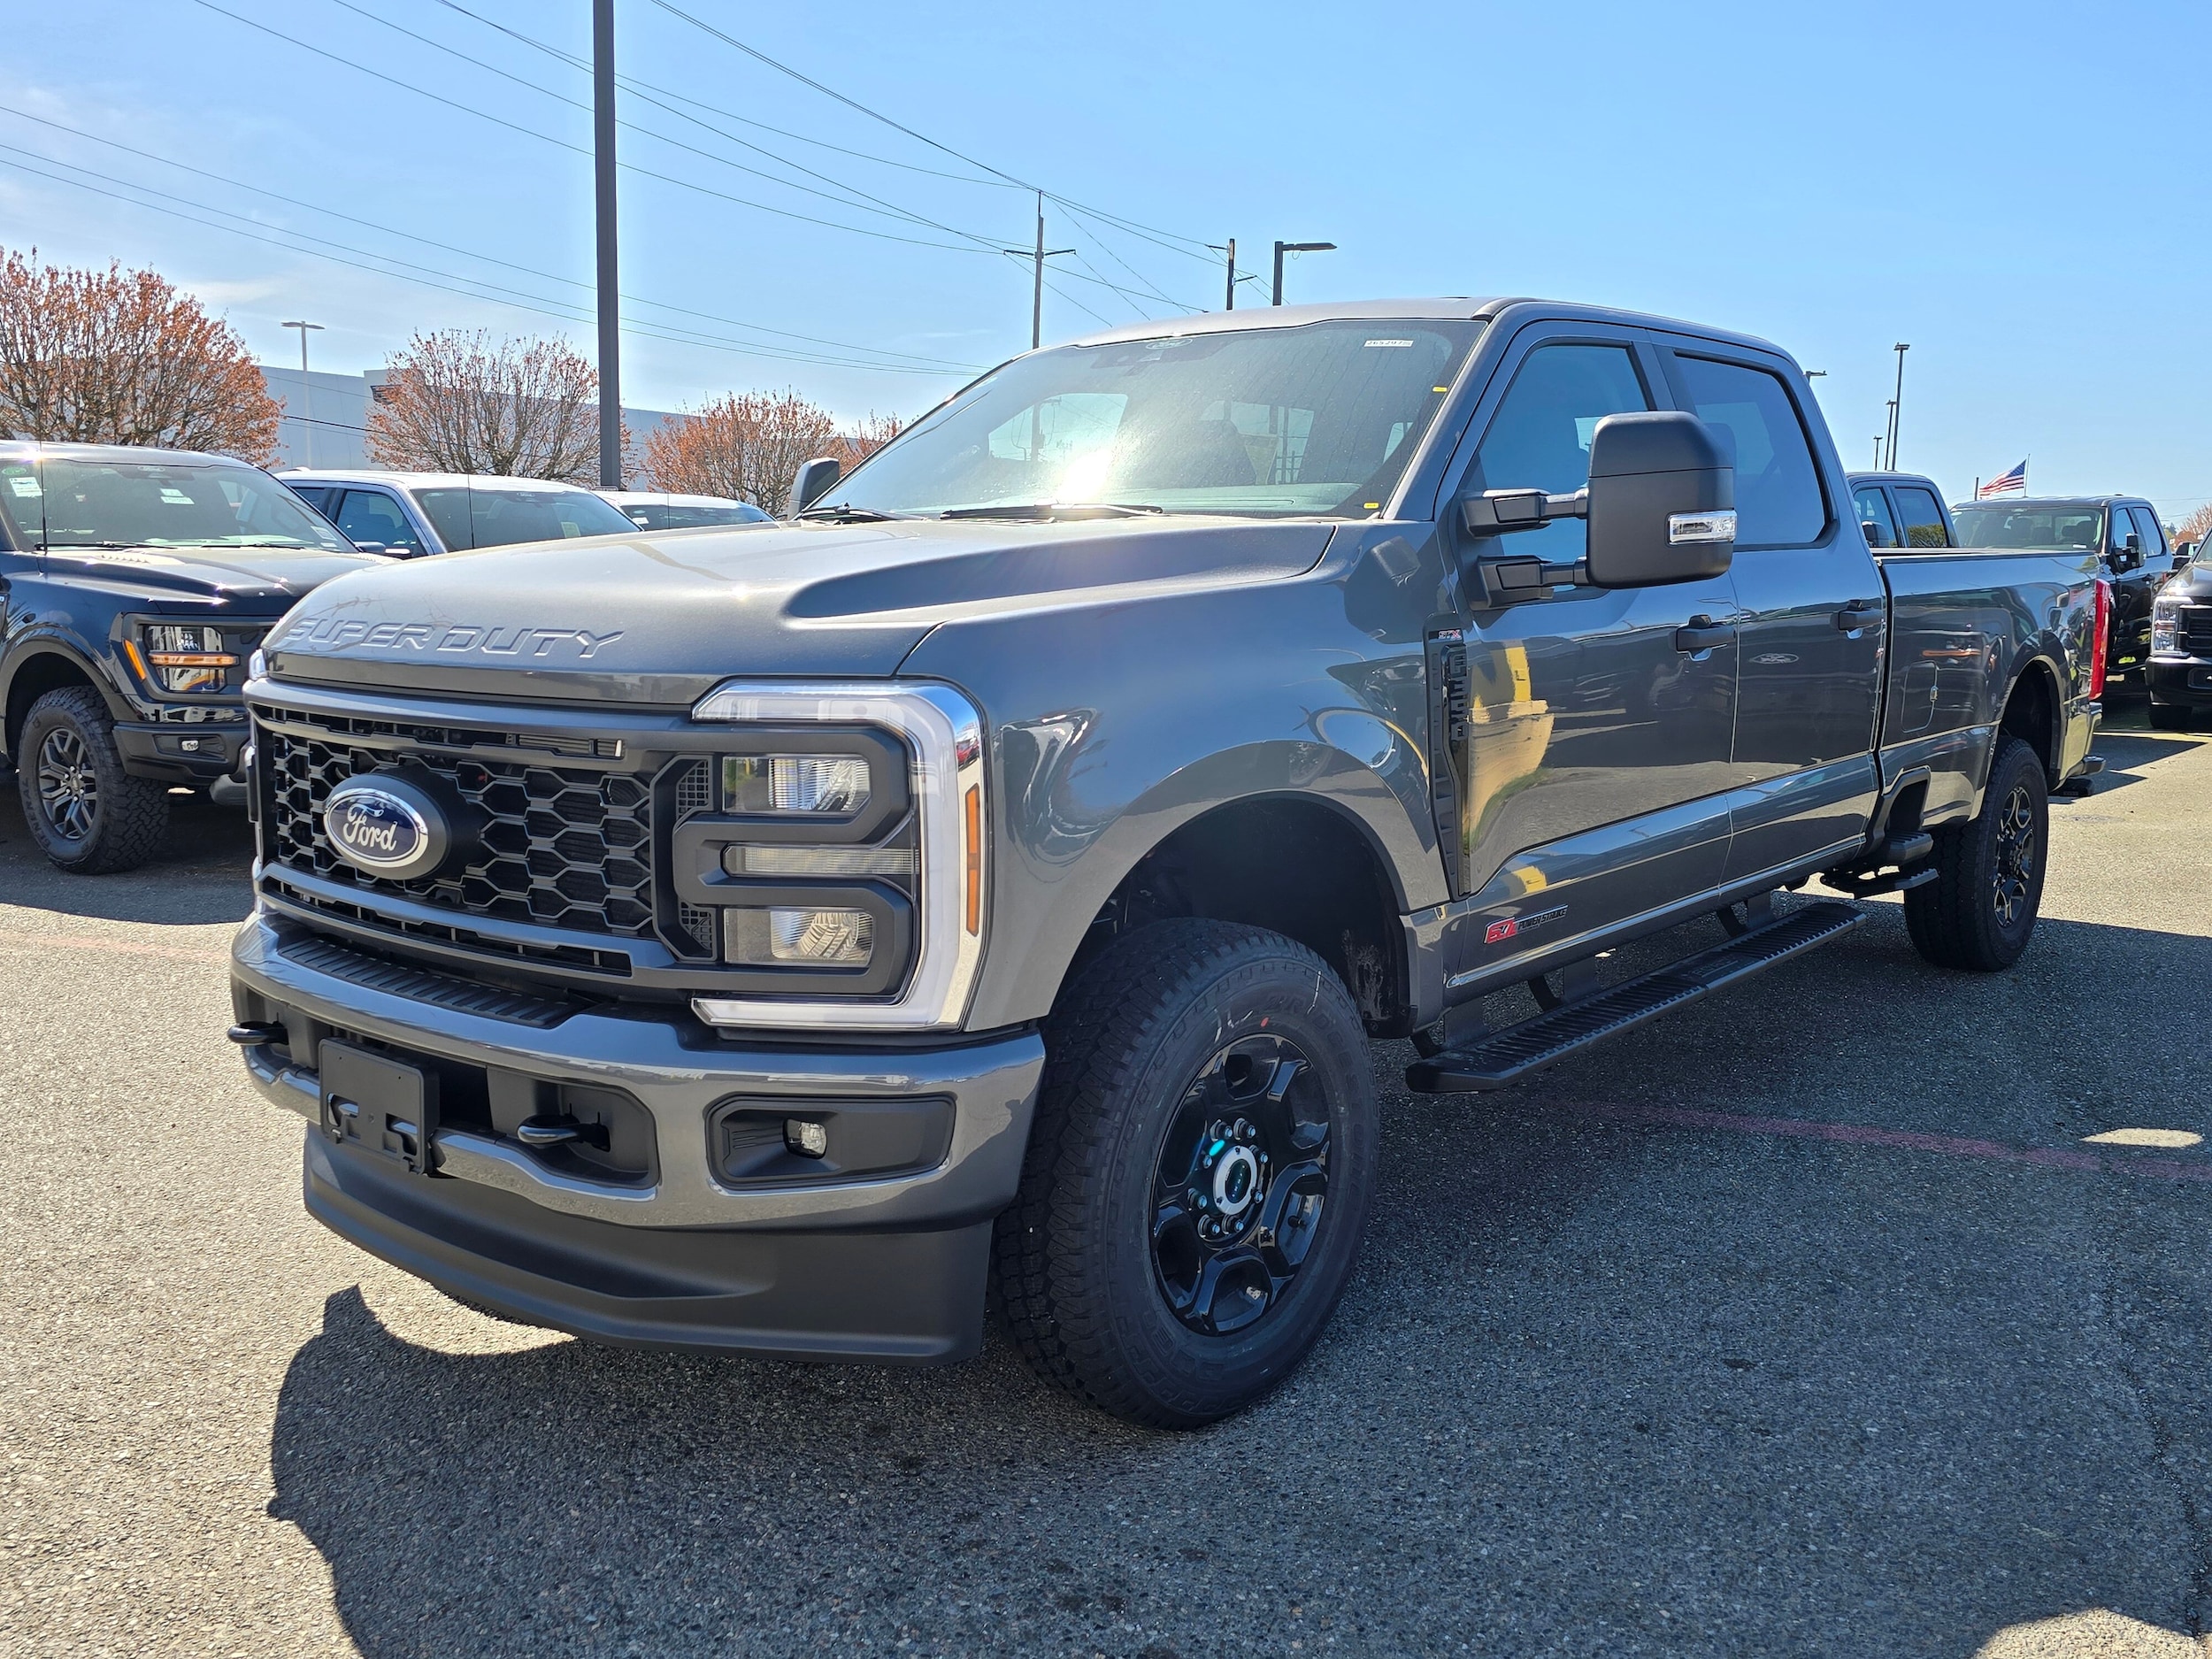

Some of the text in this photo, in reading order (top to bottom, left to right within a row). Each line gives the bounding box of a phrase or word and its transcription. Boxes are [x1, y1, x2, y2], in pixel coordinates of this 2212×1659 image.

[286, 618, 625, 658] SUPER DUTY
[1440, 628, 1463, 640] STX
[343, 803, 397, 851] Ford
